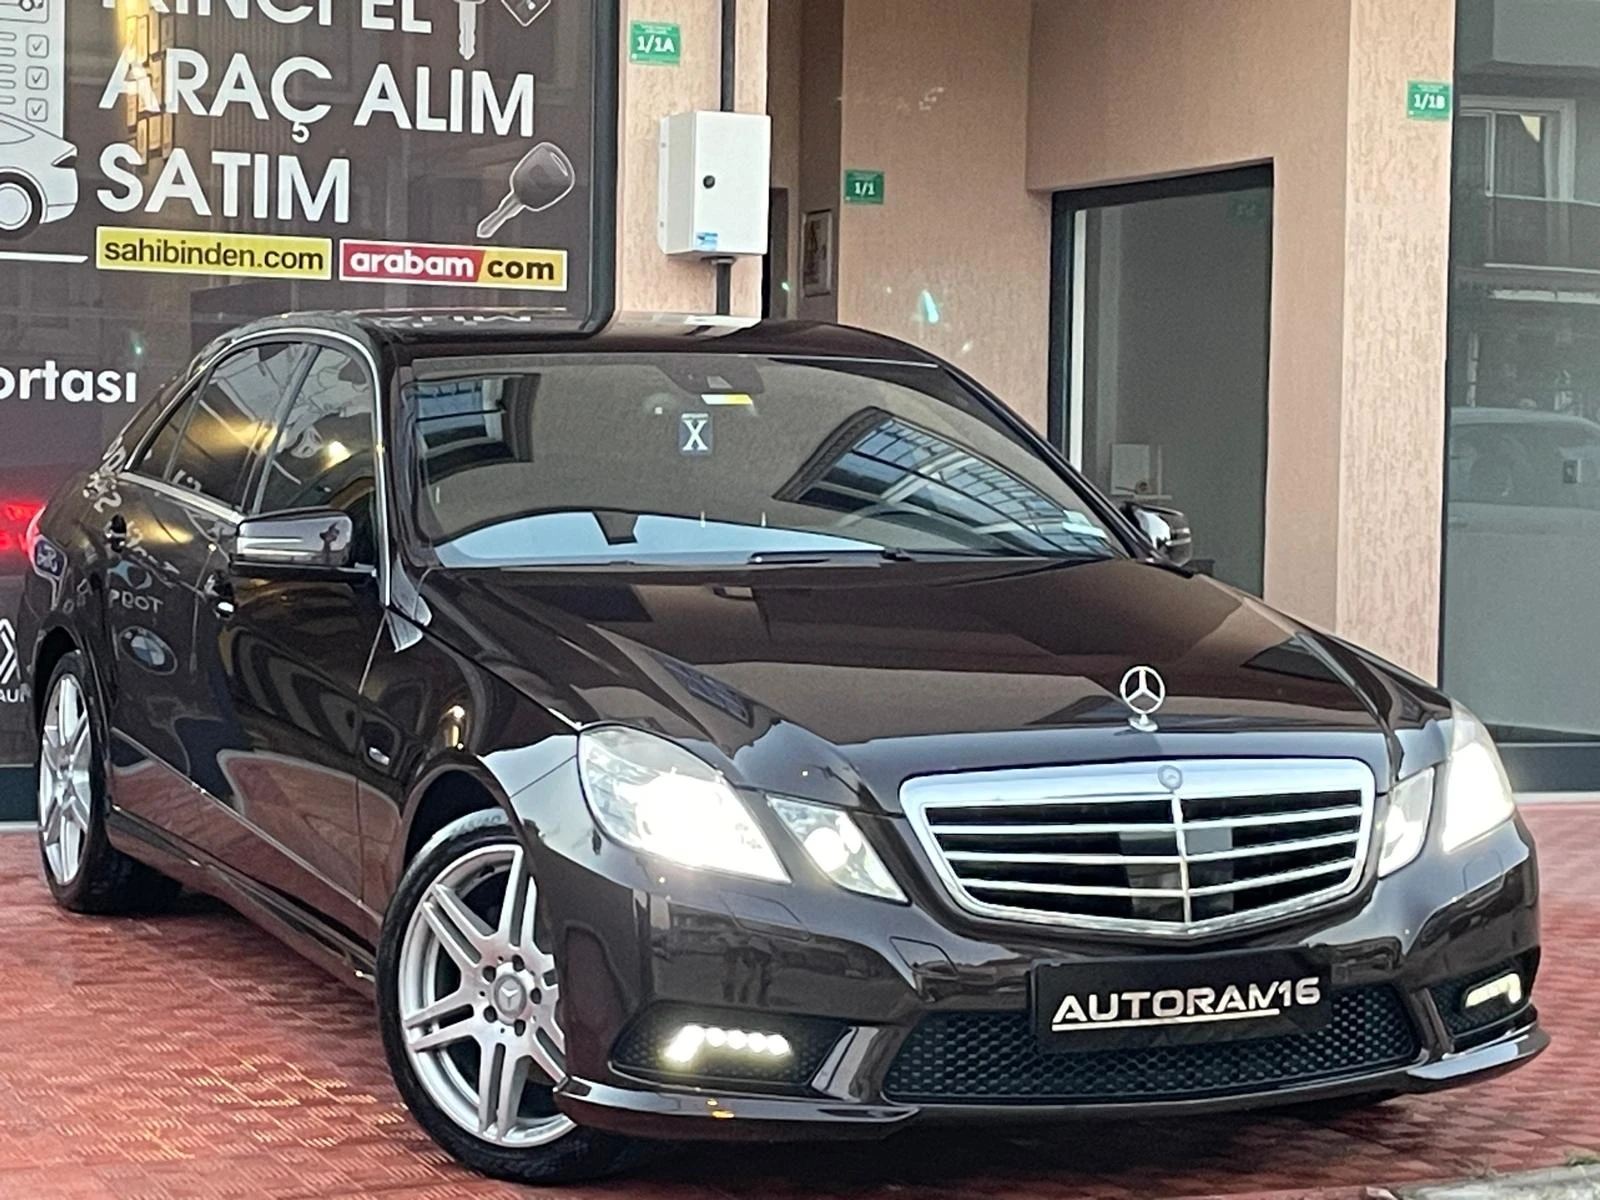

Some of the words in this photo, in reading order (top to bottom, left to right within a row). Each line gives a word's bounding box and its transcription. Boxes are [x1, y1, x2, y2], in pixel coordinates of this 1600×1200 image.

[637, 35, 675, 53] 1/1A
[99, 46, 333, 144] ARAÇ
[354, 63, 534, 138] ALIM
[97, 142, 350, 223] SATIM
[854, 182, 875, 197] 1/1
[104, 238, 324, 270] sahibinden.com
[1052, 976, 1321, 1024] AUTORAM16
